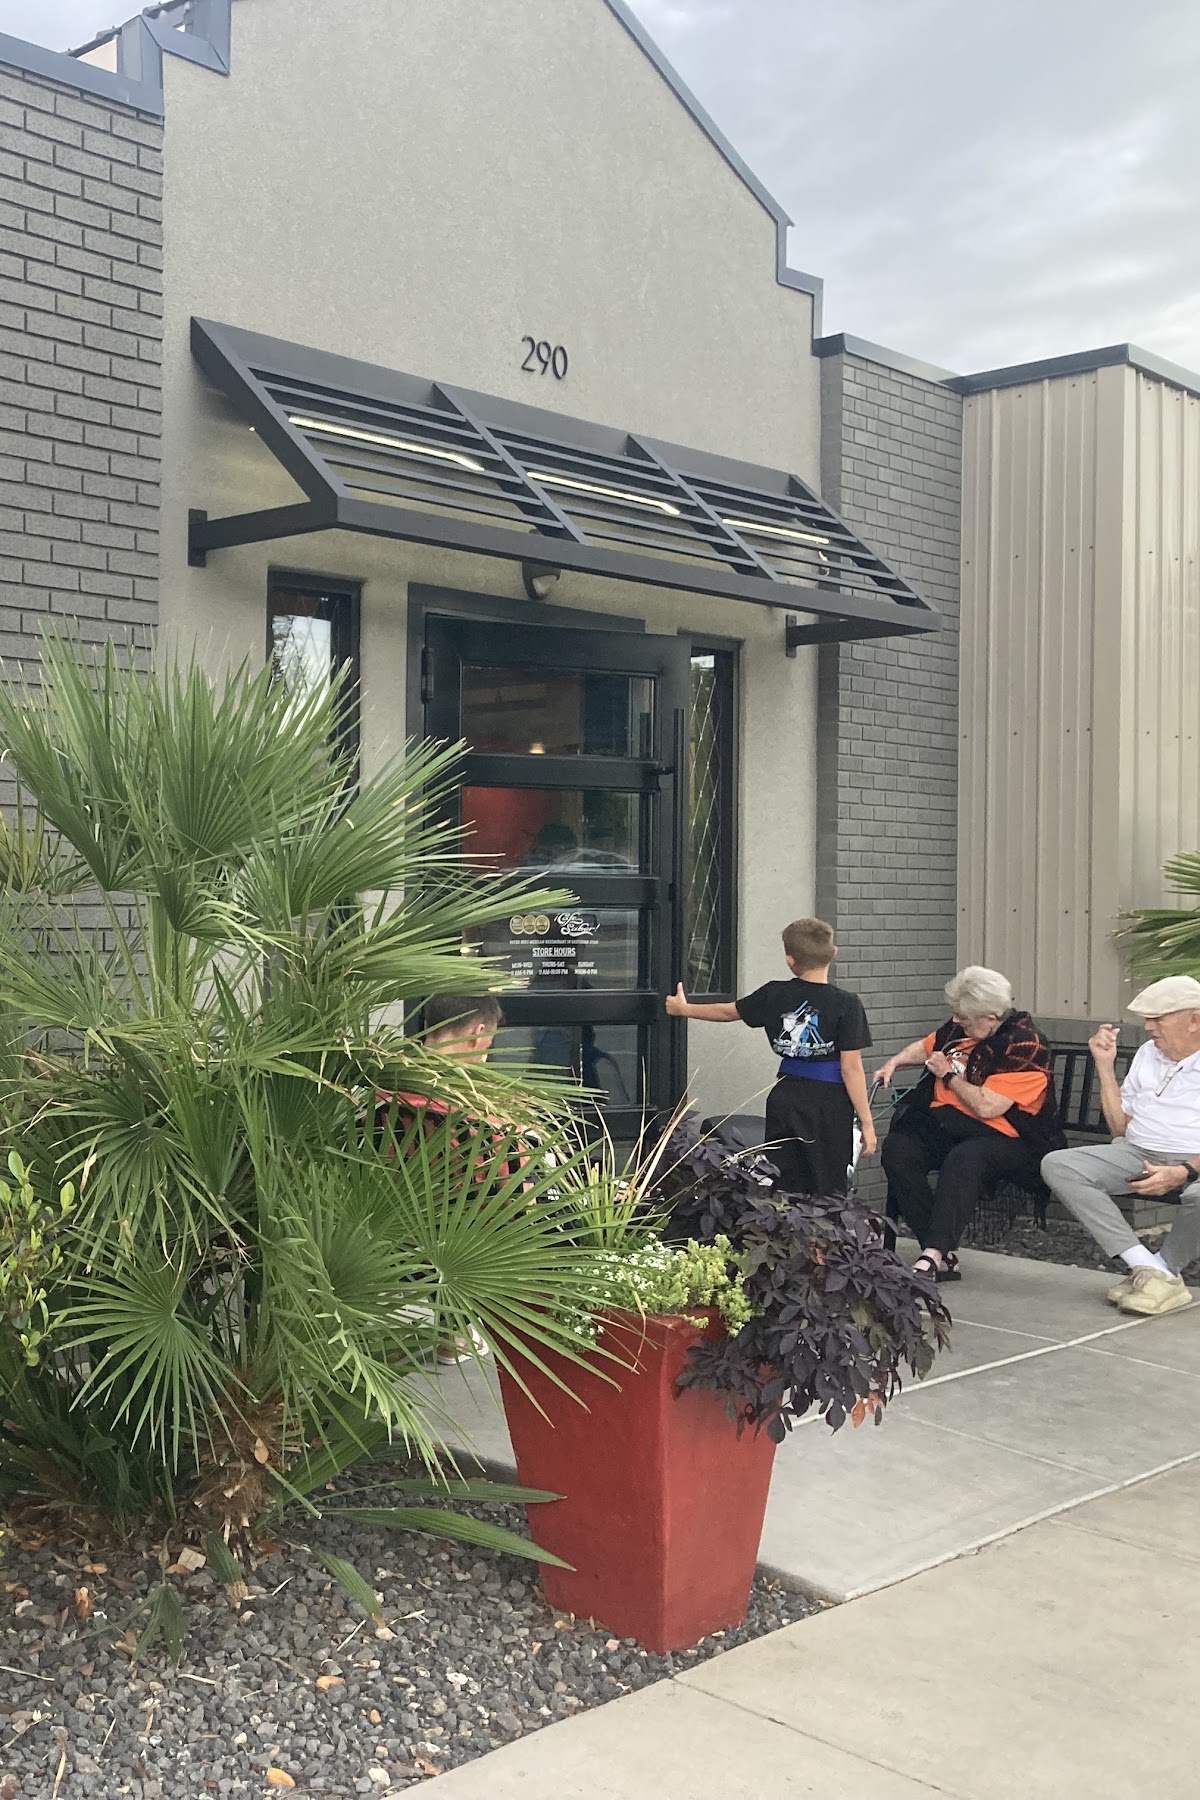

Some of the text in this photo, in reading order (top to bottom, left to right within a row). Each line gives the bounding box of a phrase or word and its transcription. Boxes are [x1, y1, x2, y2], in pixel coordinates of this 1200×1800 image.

[520, 335, 568, 380] 290
[532, 947, 576, 956] STORE HOURS
